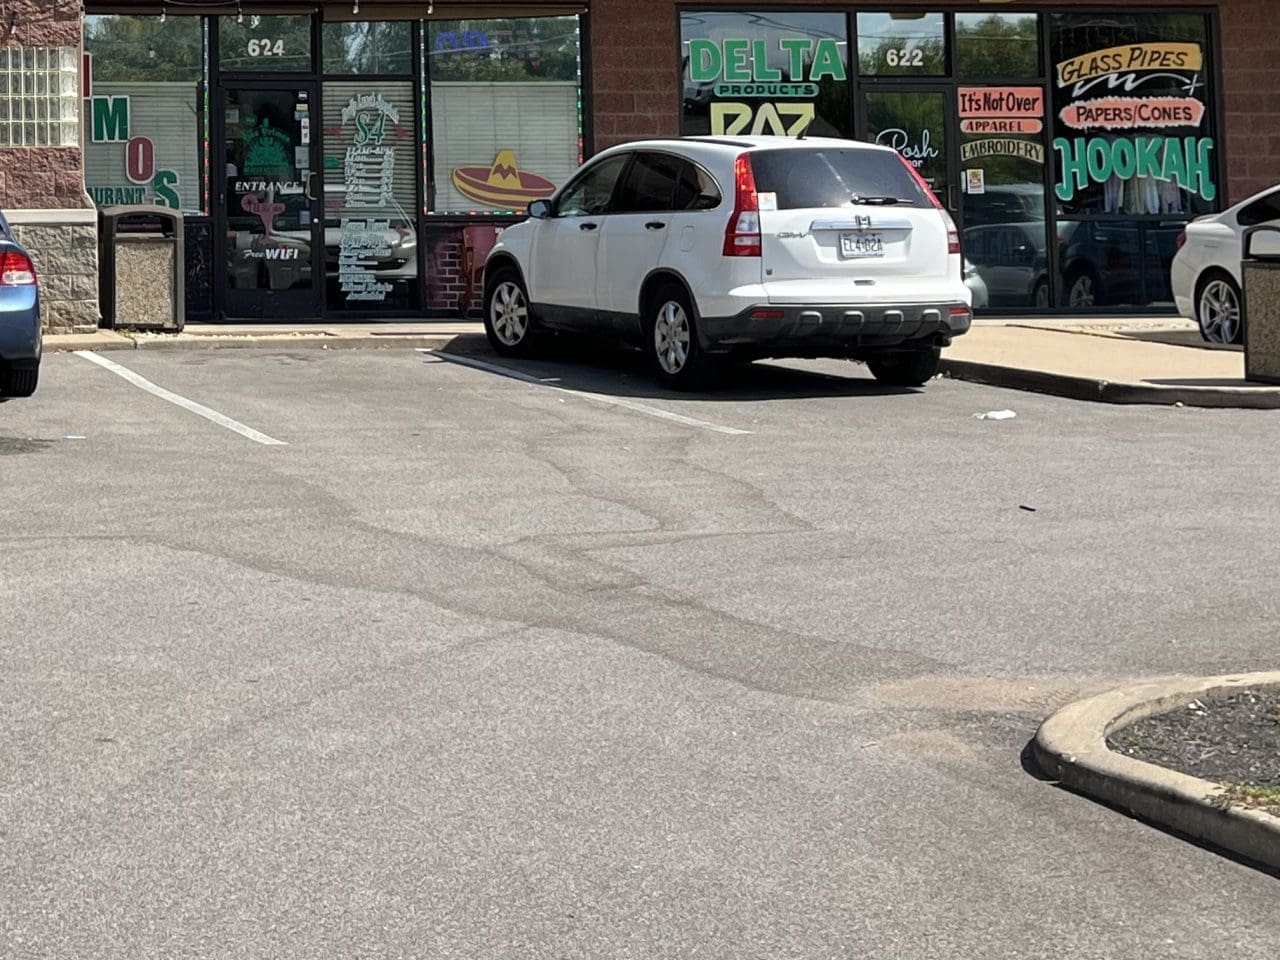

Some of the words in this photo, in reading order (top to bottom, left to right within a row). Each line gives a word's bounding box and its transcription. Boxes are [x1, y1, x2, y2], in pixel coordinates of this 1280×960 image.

[246, 38, 286, 57] 624
[688, 39, 847, 82] DELTA
[886, 49, 924, 66] 622
[1061, 52, 1122, 83] GLASS
[1127, 47, 1188, 68] PIPES
[719, 85, 816, 95] PRODUCTS
[960, 92, 981, 112] It's
[983, 91, 1005, 112] Not
[1006, 91, 1040, 112] Over
[965, 121, 1024, 132] APPAREL
[875, 128, 939, 158] Posh
[962, 141, 1042, 160] EMBROIDERY
[1053, 137, 1216, 201] HOOKAH
[235, 181, 300, 192] ENTRANCE
[243, 249, 264, 259] Free
